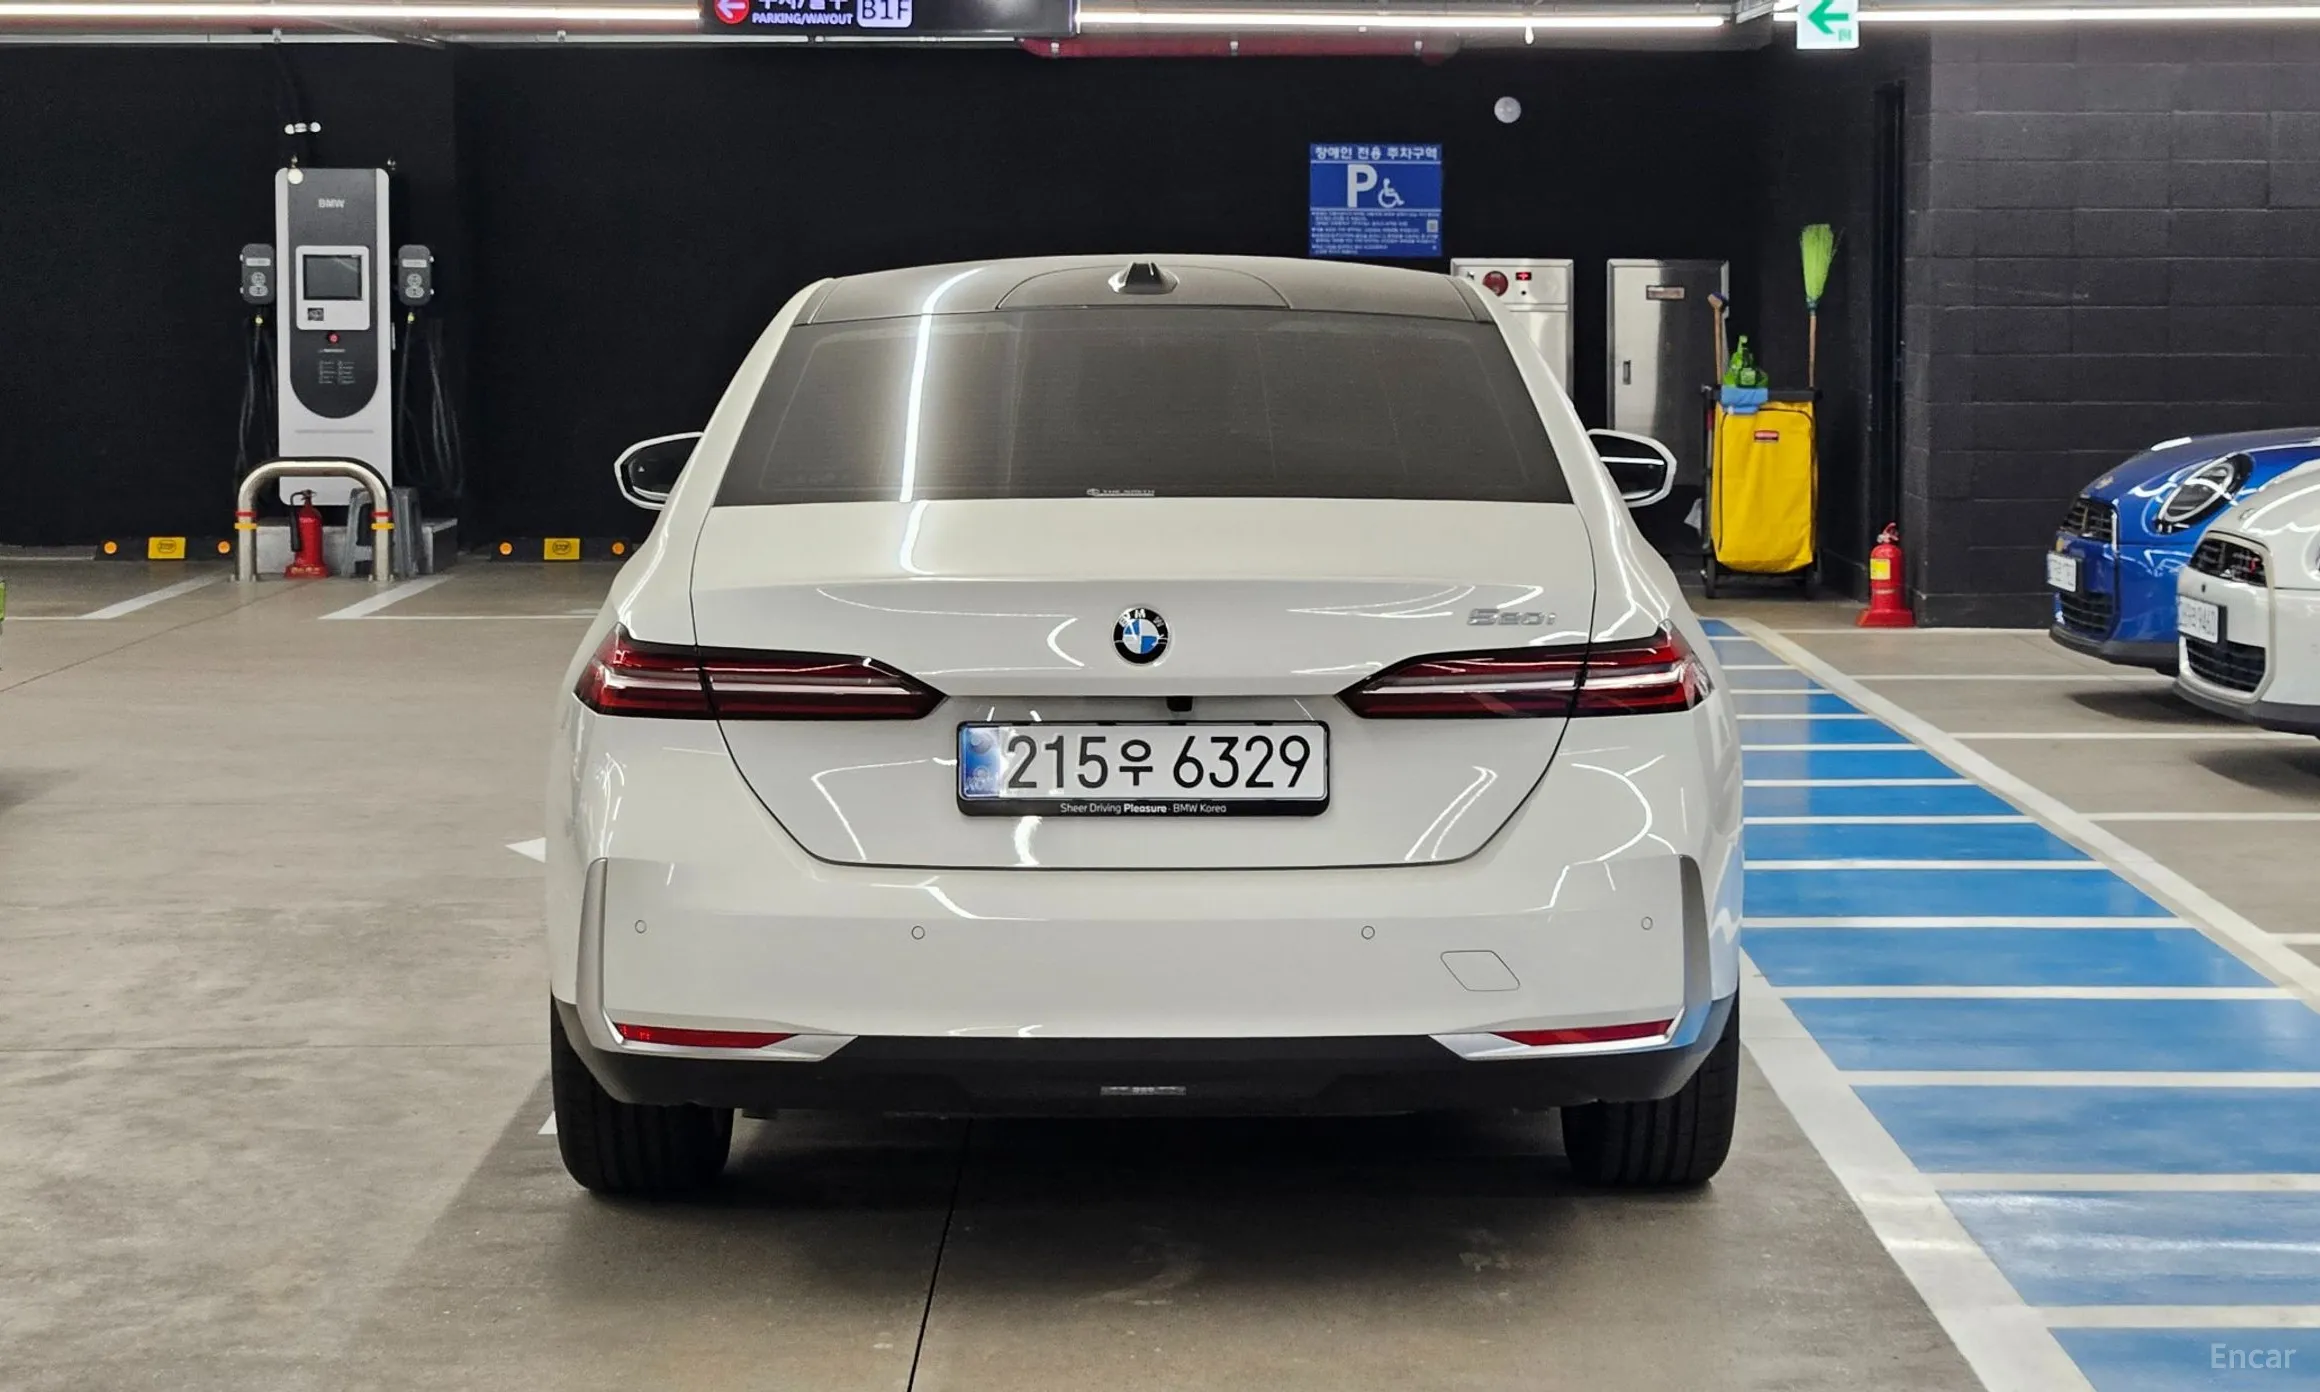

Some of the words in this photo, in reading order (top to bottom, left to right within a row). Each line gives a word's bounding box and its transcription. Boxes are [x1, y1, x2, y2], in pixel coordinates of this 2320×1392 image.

[861, 0, 908, 20] B1F
[751, 12, 853, 25] PARKING/WAYOUT
[1347, 164, 1377, 208] P
[318, 198, 345, 208] BMW
[1007, 735, 1153, 788] 215우
[1173, 735, 1311, 788] 6329
[1060, 803, 1087, 813] Sheer
[1090, 803, 1121, 814] Driving
[1124, 803, 1167, 813] Pleasure
[1173, 803, 1198, 813] BMW
[1200, 803, 1227, 813] Korea
